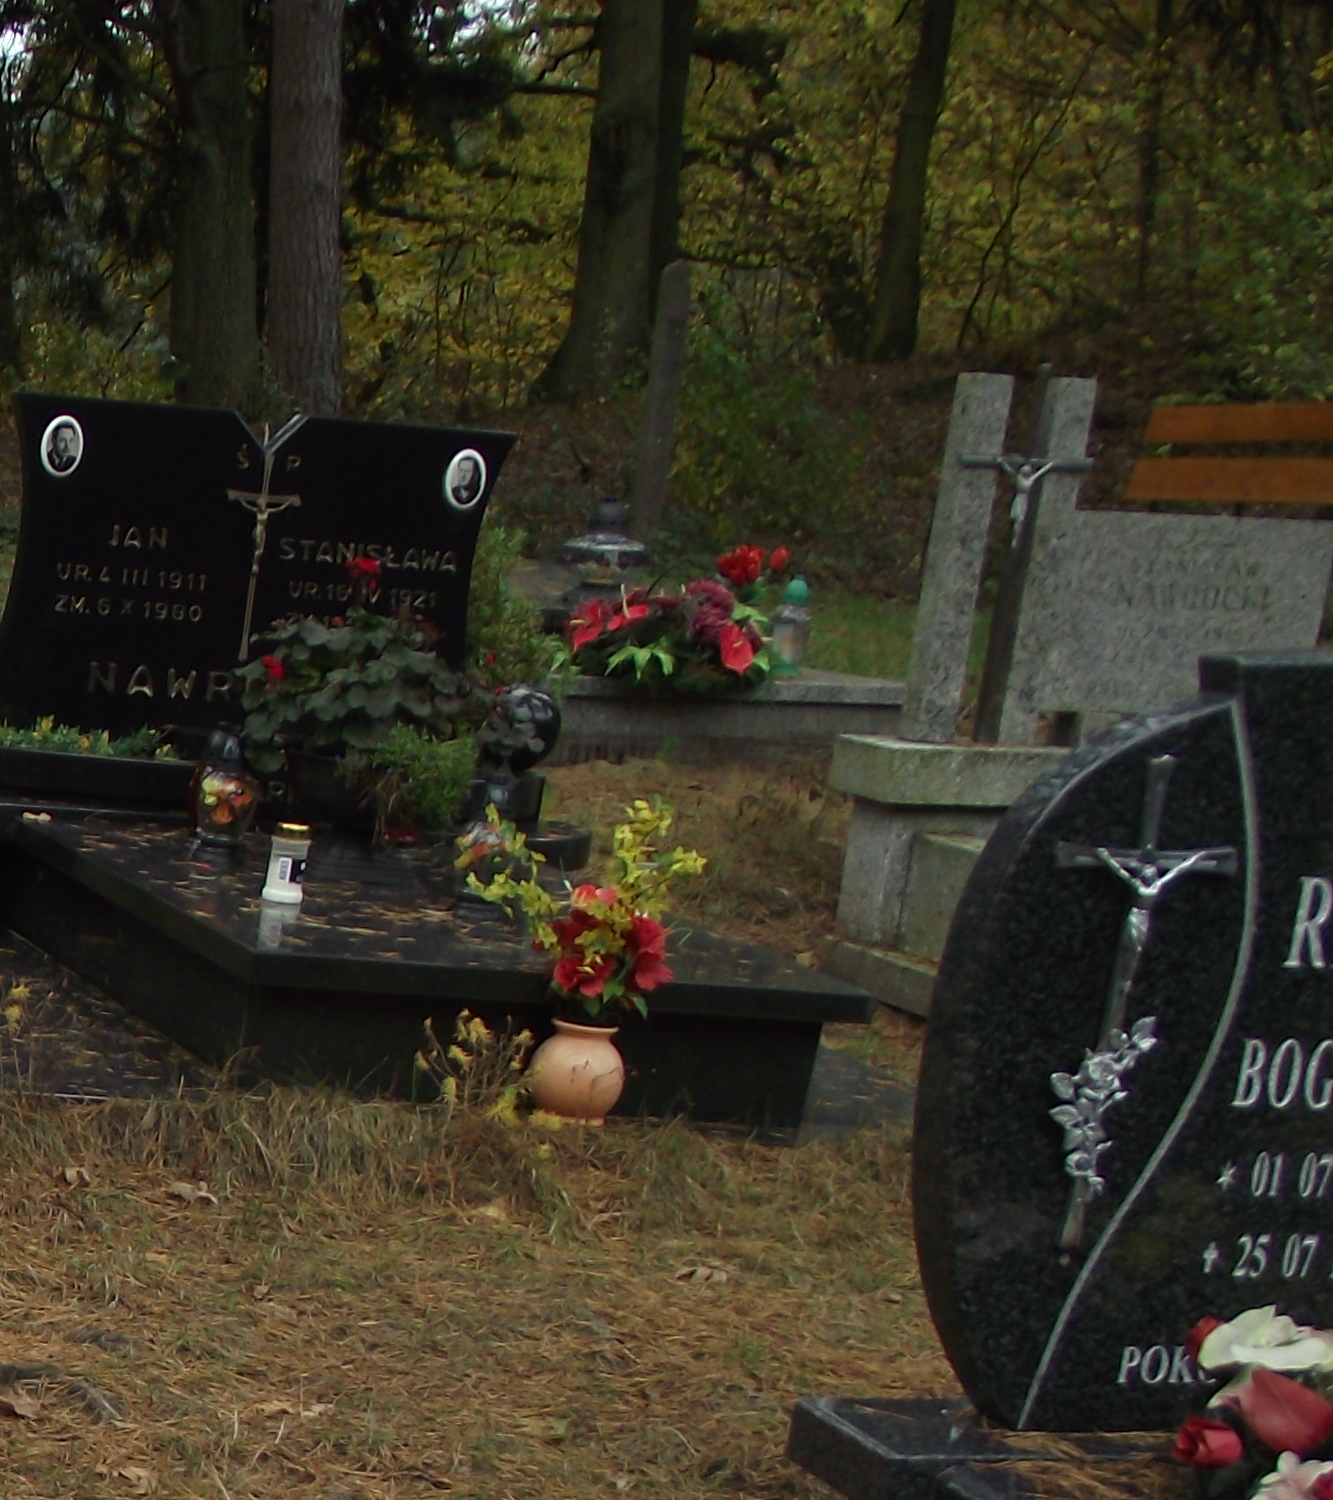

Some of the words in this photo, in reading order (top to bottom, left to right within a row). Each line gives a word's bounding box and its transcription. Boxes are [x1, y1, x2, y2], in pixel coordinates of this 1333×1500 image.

[108, 523, 169, 550] JAN
[279, 537, 458, 573] STANISŁAWA
[158, 570, 208, 591] 1911
[53, 593, 92, 615] ZM.
[143, 600, 203, 623] 1980
